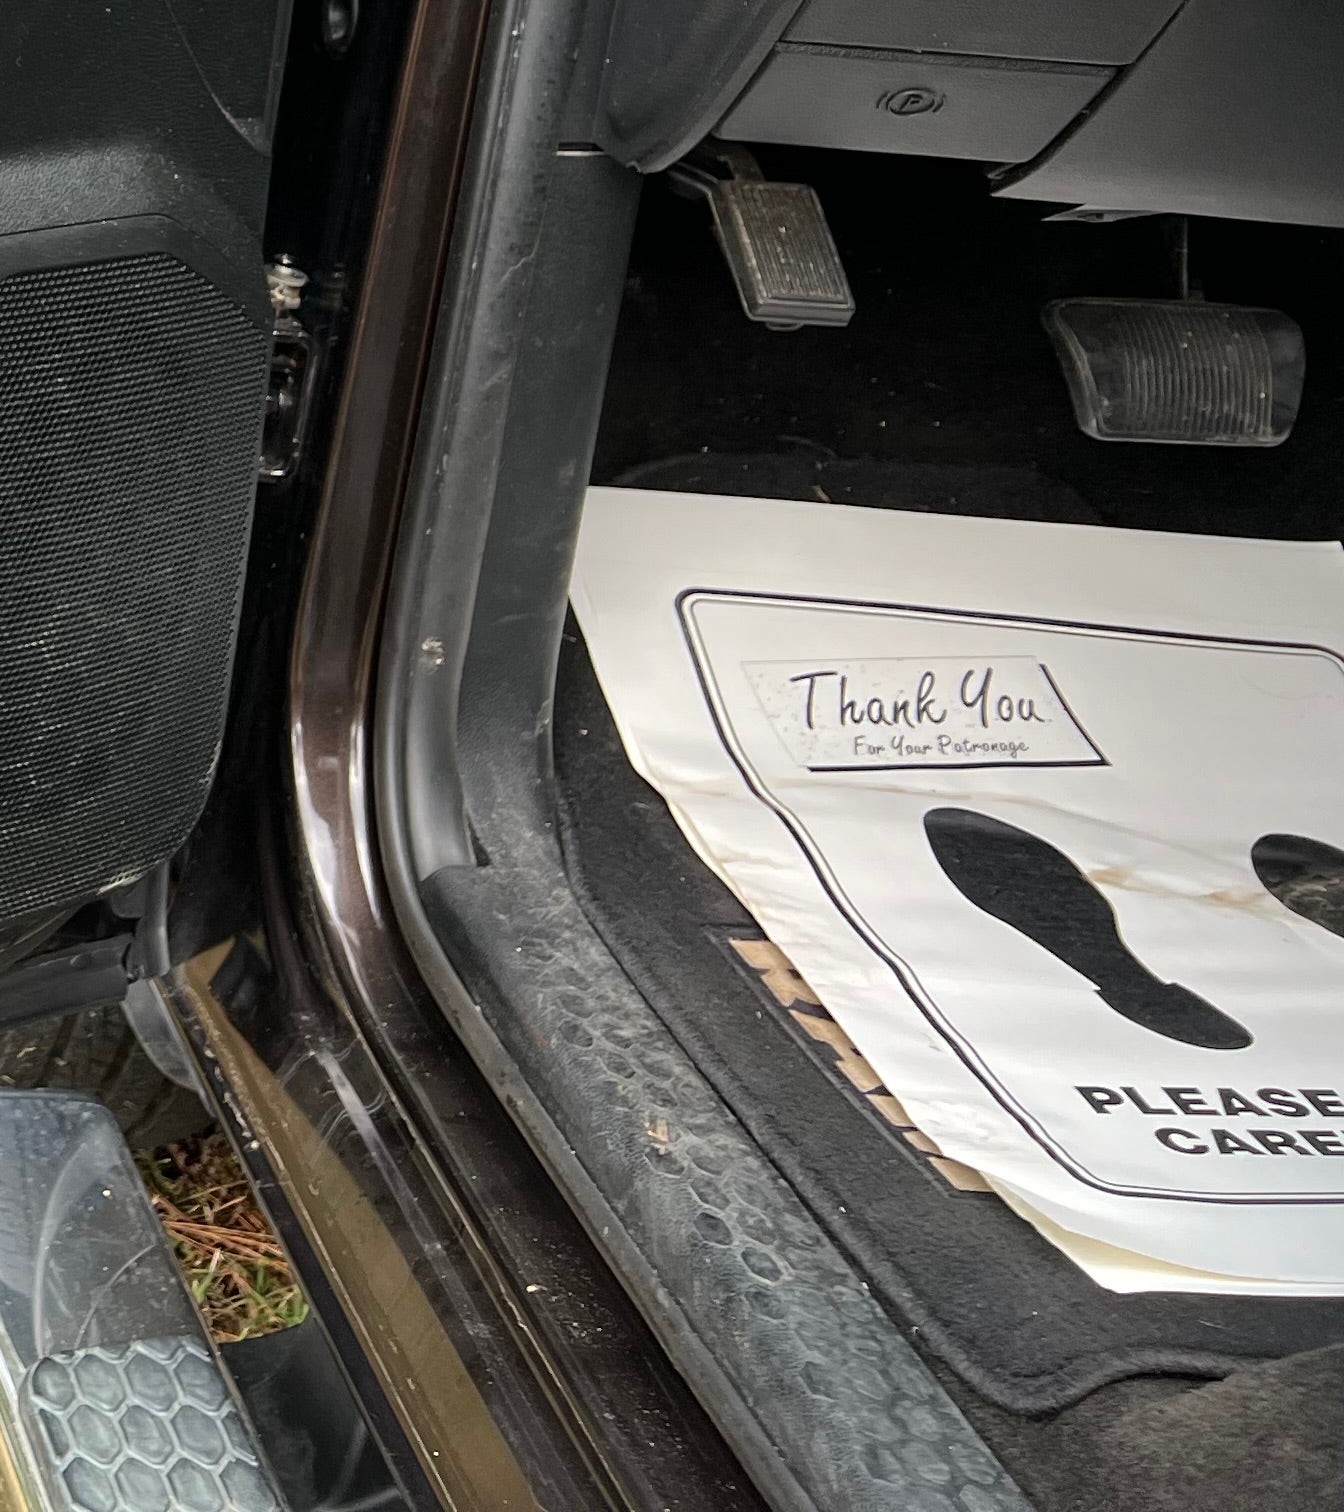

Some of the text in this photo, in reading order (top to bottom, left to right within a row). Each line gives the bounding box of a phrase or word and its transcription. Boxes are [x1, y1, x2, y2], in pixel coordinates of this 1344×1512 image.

[789, 666, 1045, 730] Thank You
[853, 735, 1030, 758] For Your Patronage
[1073, 1085, 1344, 1118] PLEASE
[1154, 1126, 1344, 1157] CARE
